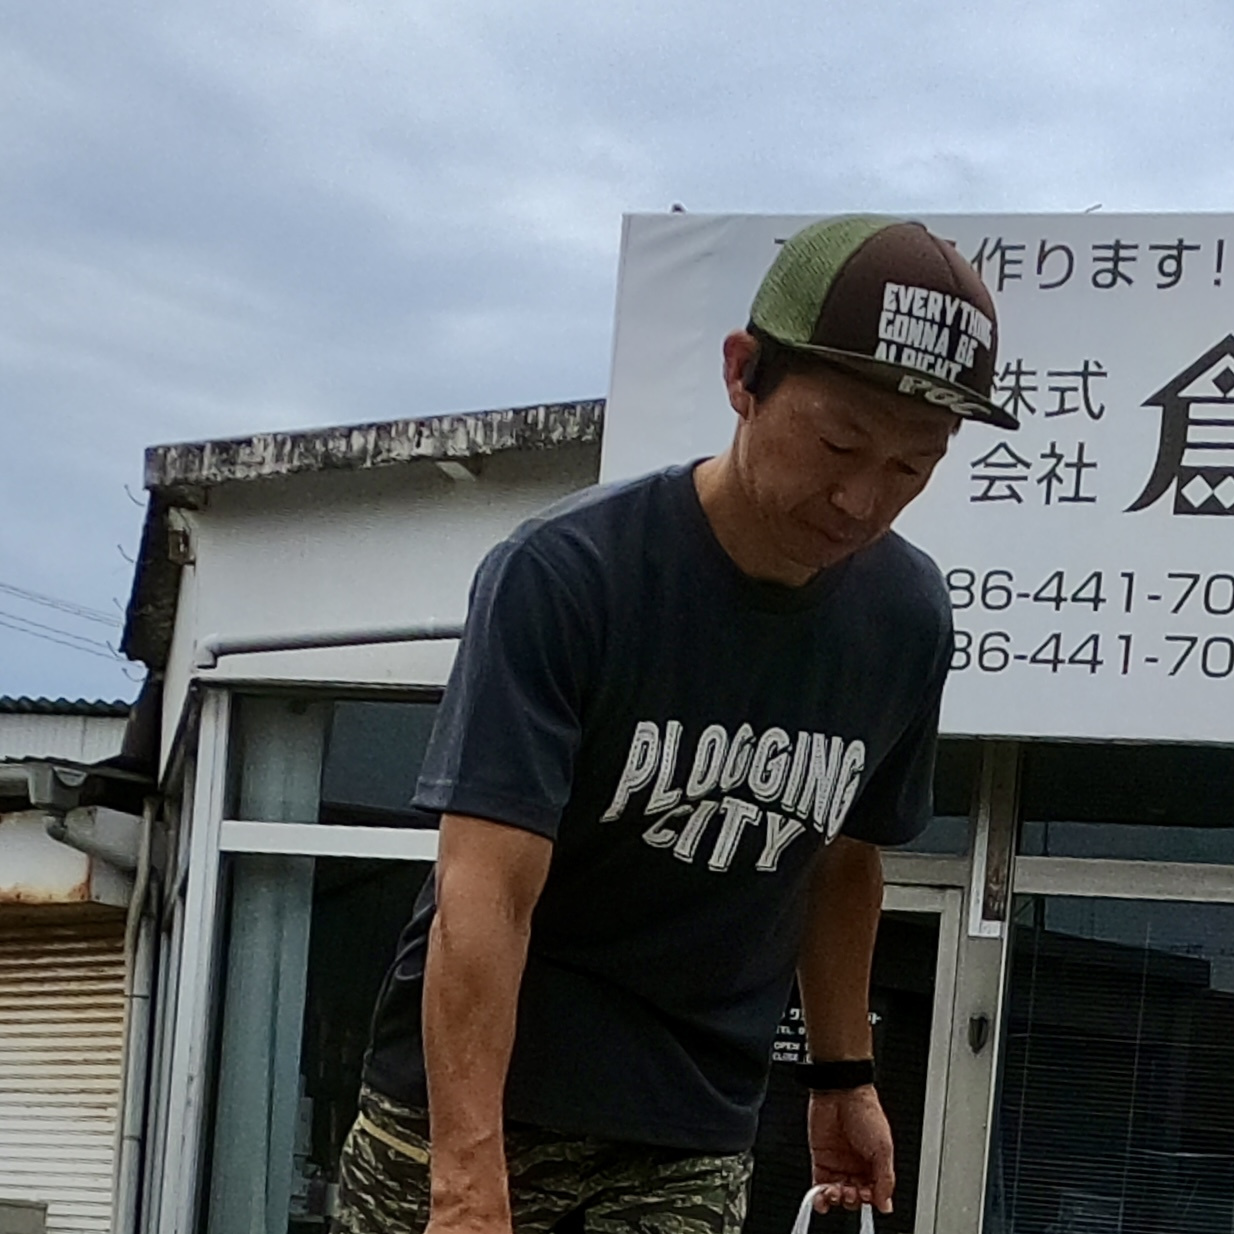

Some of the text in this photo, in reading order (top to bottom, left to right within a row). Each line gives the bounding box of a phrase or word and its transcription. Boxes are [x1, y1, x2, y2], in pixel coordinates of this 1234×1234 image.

[879, 311, 978, 368] GONNA BE
[883, 281, 993, 351] EVERYTHING
[992, 358, 1108, 421] 株式
[970, 440, 1099, 506] 会社
[600, 719, 867, 846] PLOGGING
[641, 796, 807, 873] CITY
